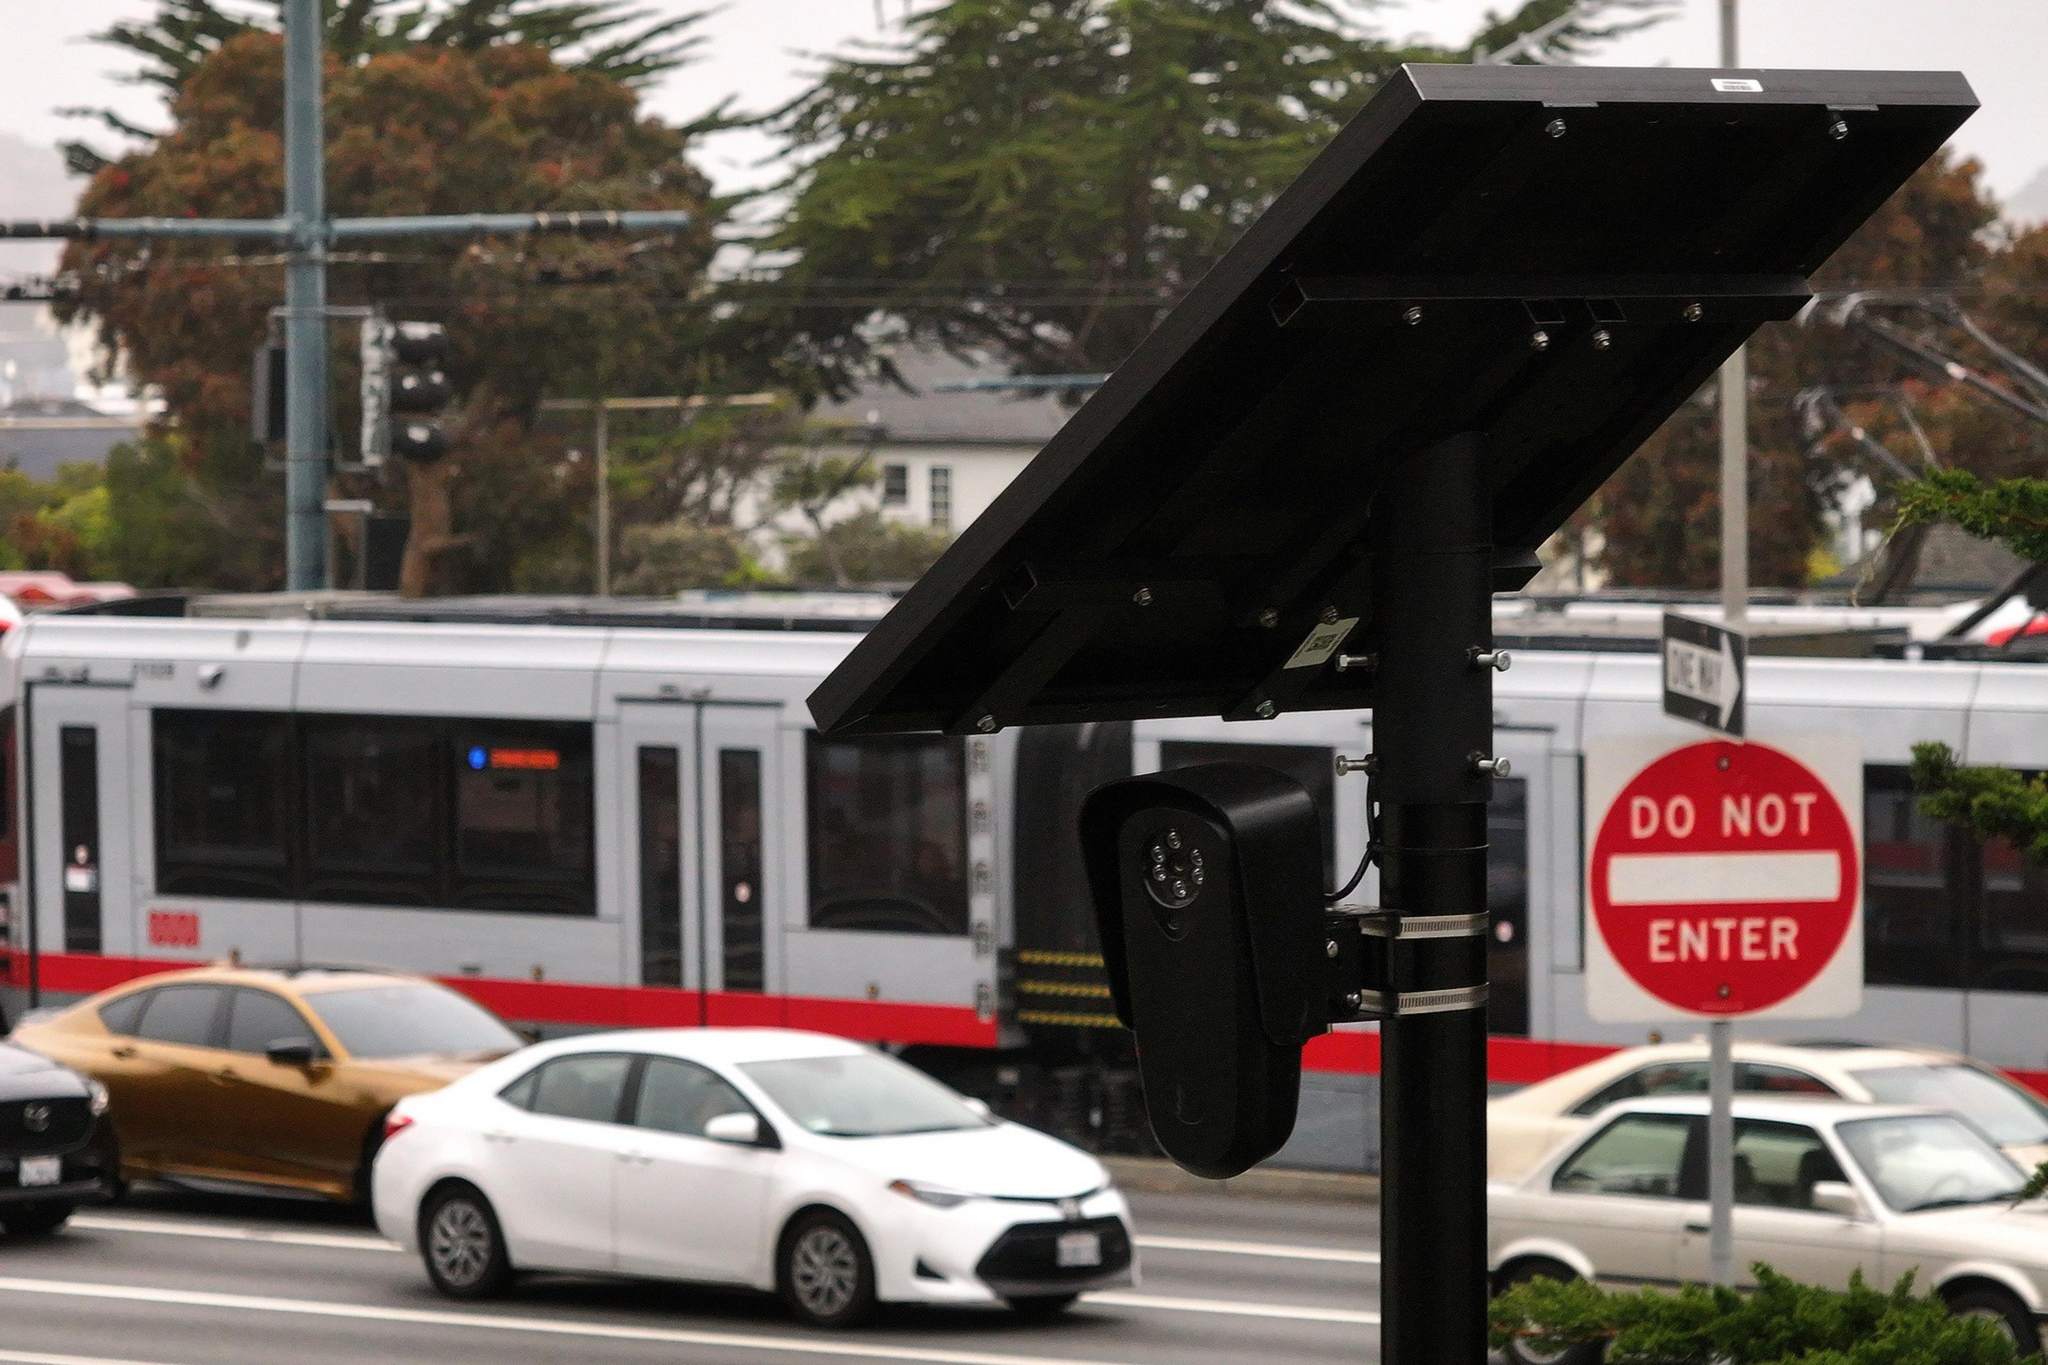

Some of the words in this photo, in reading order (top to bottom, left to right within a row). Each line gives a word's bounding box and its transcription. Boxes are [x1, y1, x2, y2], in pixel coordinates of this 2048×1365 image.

[1631, 796, 1695, 839] DO
[1722, 794, 1816, 836] NOT
[1649, 918, 1799, 962] ENTER
